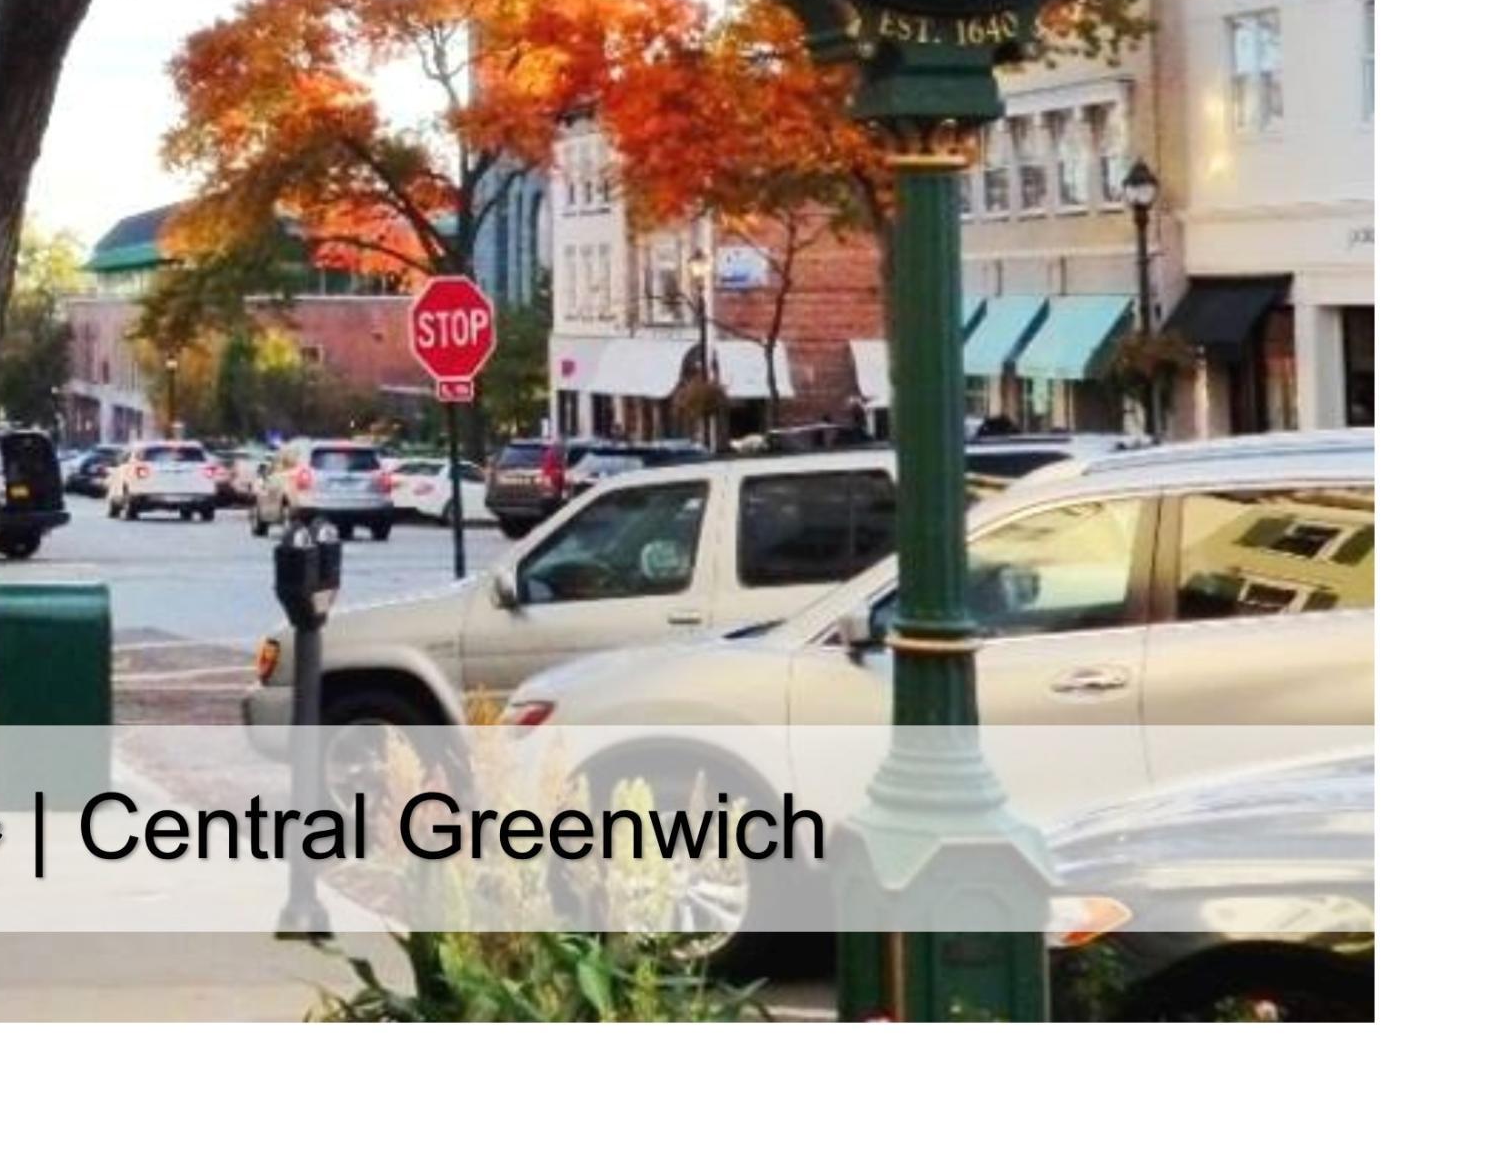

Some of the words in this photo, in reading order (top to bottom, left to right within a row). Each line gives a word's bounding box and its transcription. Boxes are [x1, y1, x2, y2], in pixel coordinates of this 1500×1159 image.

[879, 10, 943, 43] EST.
[956, 10, 1020, 45] 1640
[417, 308, 489, 349] STOP
